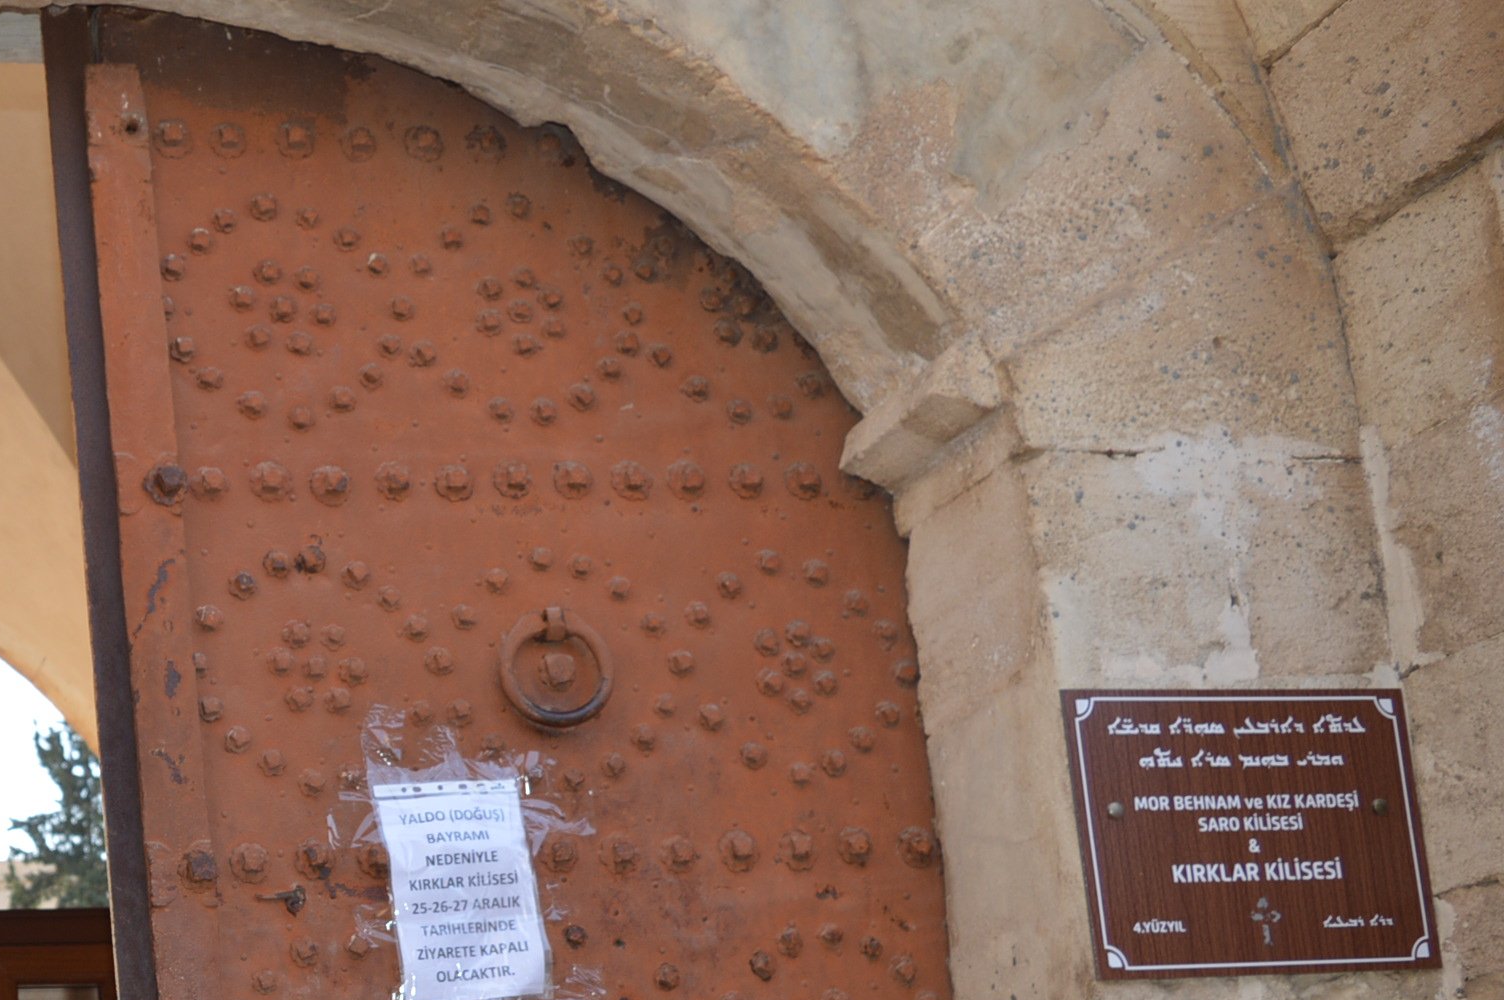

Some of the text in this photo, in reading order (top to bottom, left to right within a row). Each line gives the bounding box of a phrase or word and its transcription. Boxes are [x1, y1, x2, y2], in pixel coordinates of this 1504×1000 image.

[1134, 790, 1360, 812] MOR BEHNAM ve KIZ KARDEŞİ
[399, 810, 446, 825] YALDO
[1198, 813, 1304, 832] SARO KİLİSESİ
[426, 830, 490, 844] BAYRAMI
[1248, 838, 1261, 853] &
[425, 849, 499, 867] NEDENİYLE
[1171, 857, 1343, 884] KIRKLAR KİLİSESİ
[409, 870, 519, 892] KIRKLAR KİLİSESİ
[412, 896, 521, 915] 25-26-27 ARALIK
[420, 919, 517, 937] TARİHLERİNDE
[417, 941, 529, 960] ZİYARETE KAPALI
[436, 965, 516, 983] OLACAKTIR.
